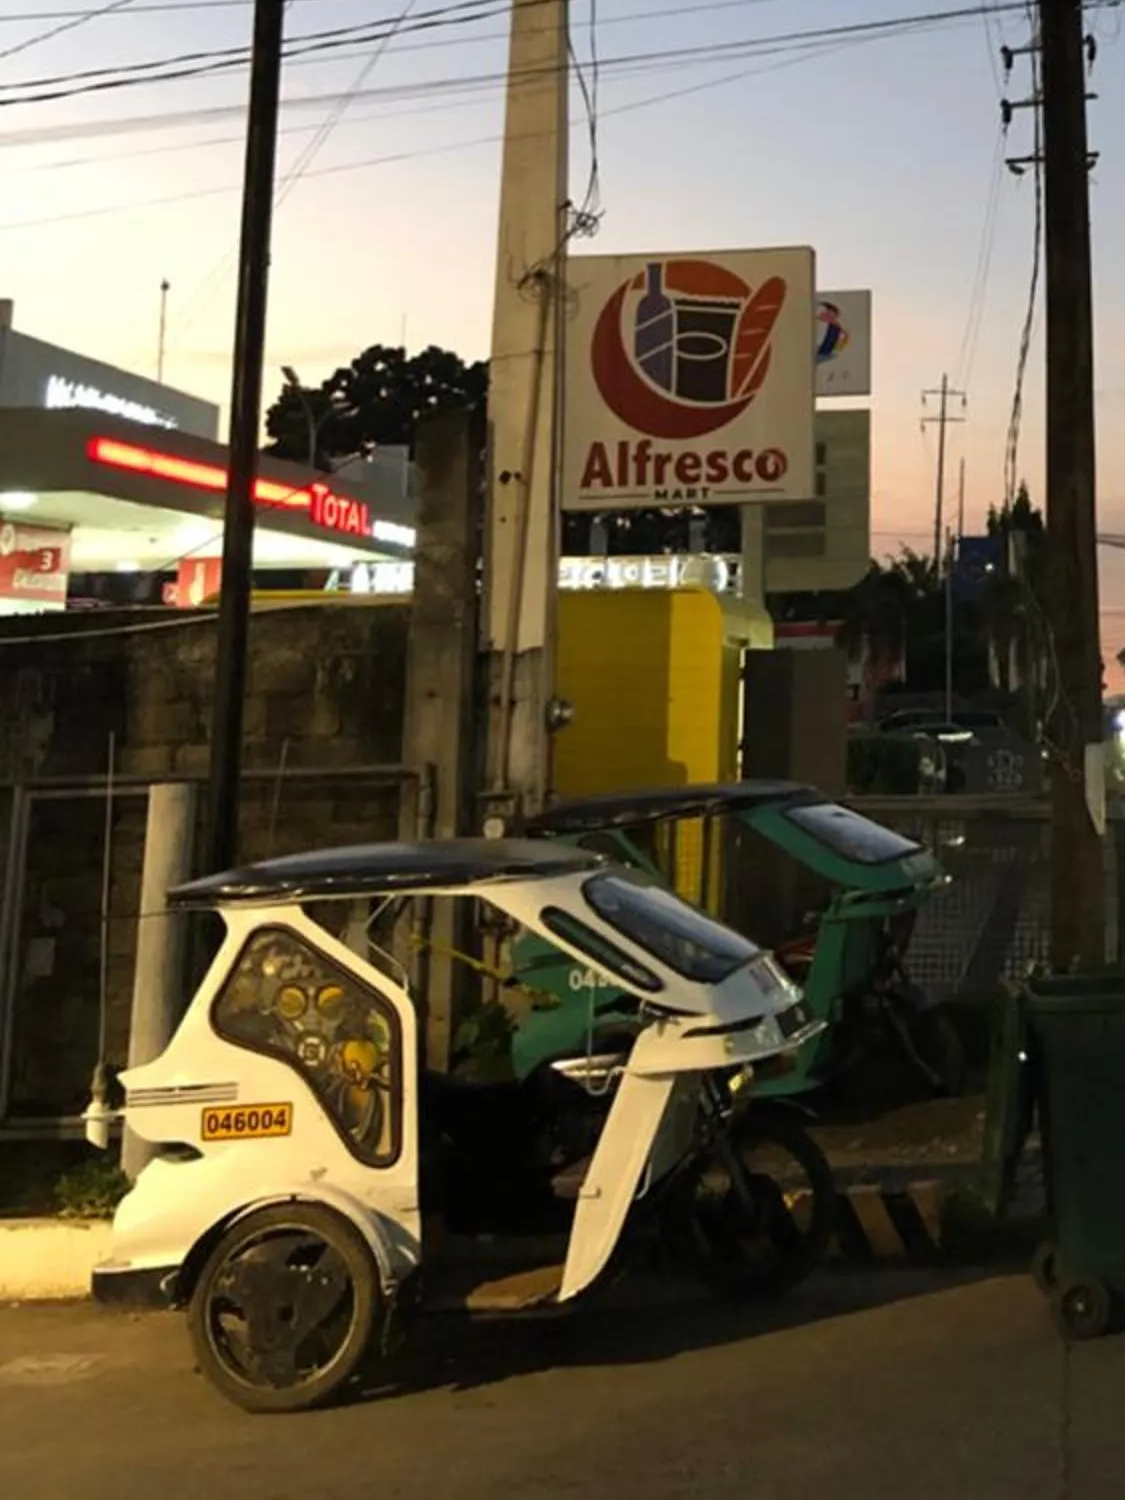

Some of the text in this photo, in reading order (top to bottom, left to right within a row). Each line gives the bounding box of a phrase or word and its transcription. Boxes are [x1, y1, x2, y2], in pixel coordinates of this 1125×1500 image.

[580, 440, 788, 489] Alfresco
[311, 483, 372, 536] TOTAL
[654, 486, 711, 501] MART
[207, 1108, 287, 1134] 046004
